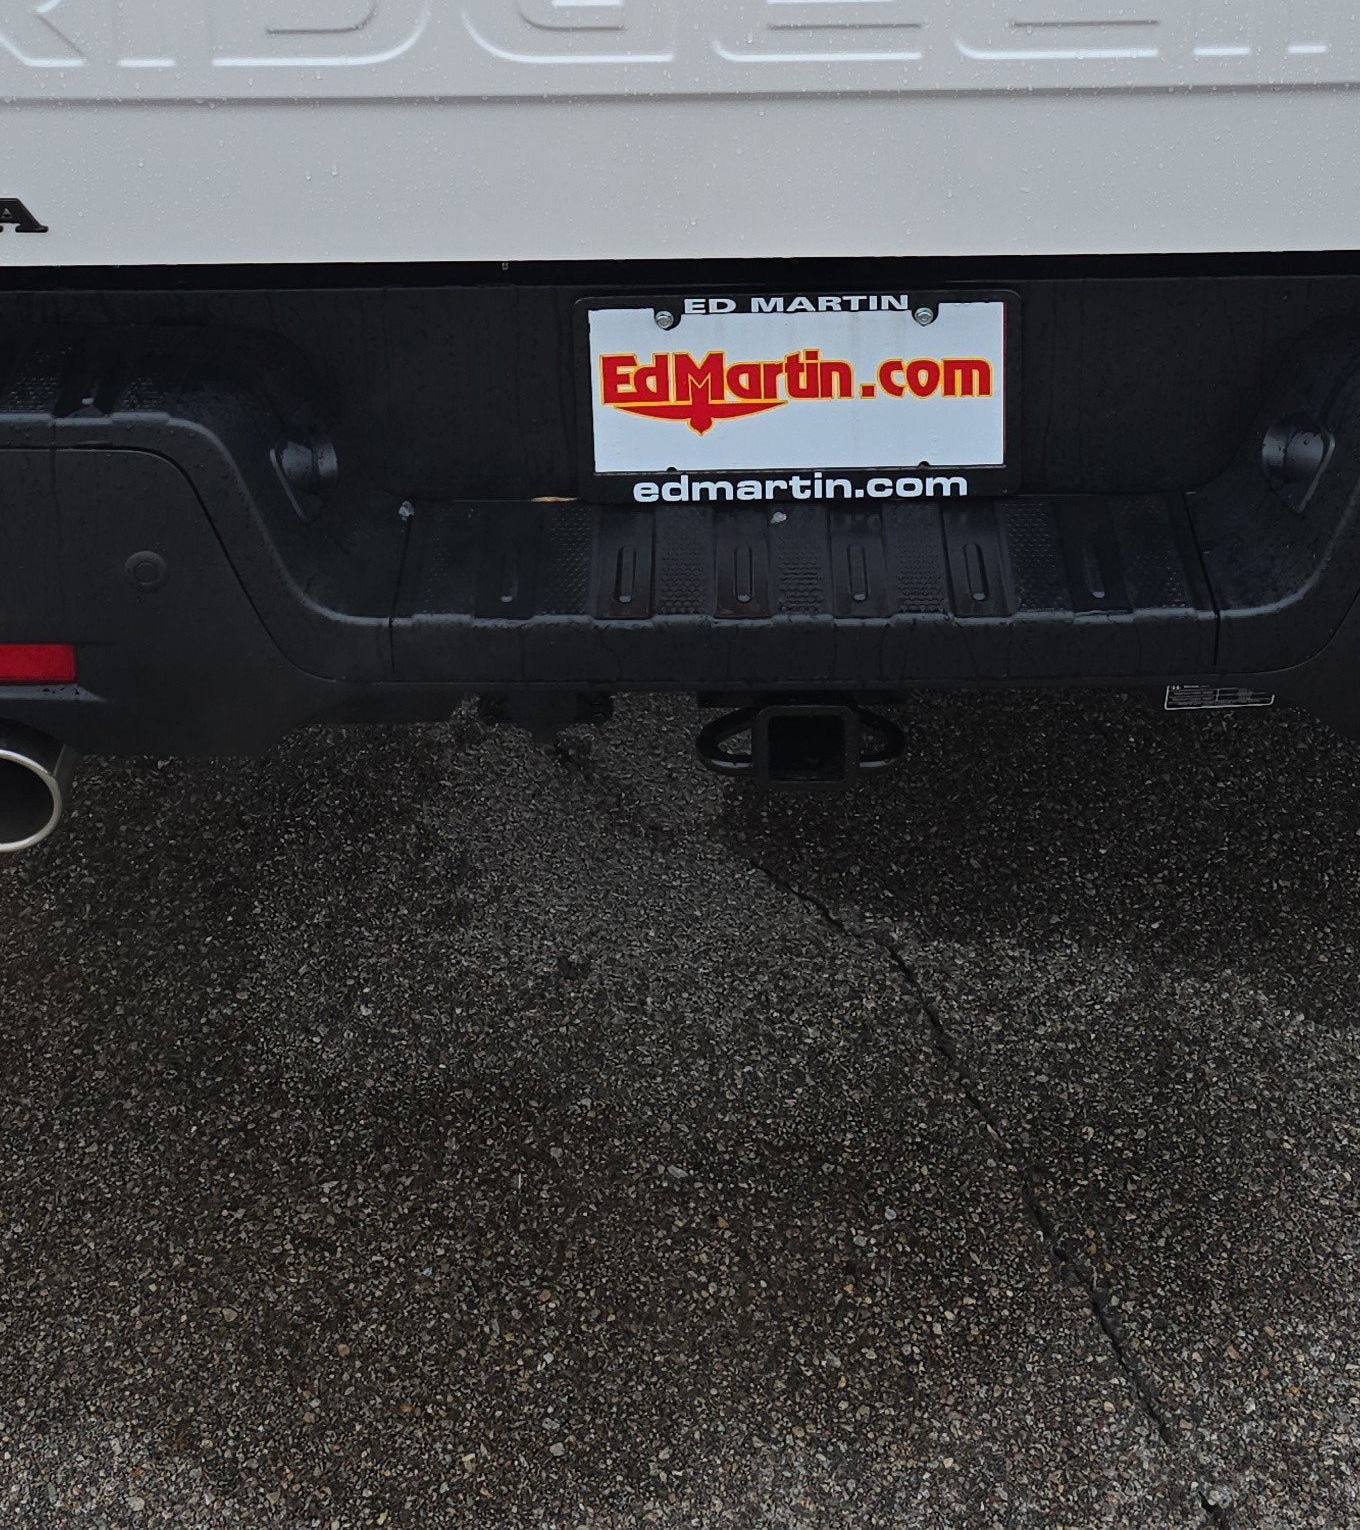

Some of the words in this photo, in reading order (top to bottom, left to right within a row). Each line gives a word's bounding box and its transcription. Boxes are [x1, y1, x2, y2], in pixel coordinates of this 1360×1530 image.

[683, 298, 735, 315] ED
[750, 294, 909, 313] MARTIN
[632, 472, 968, 503] edmartin.com
